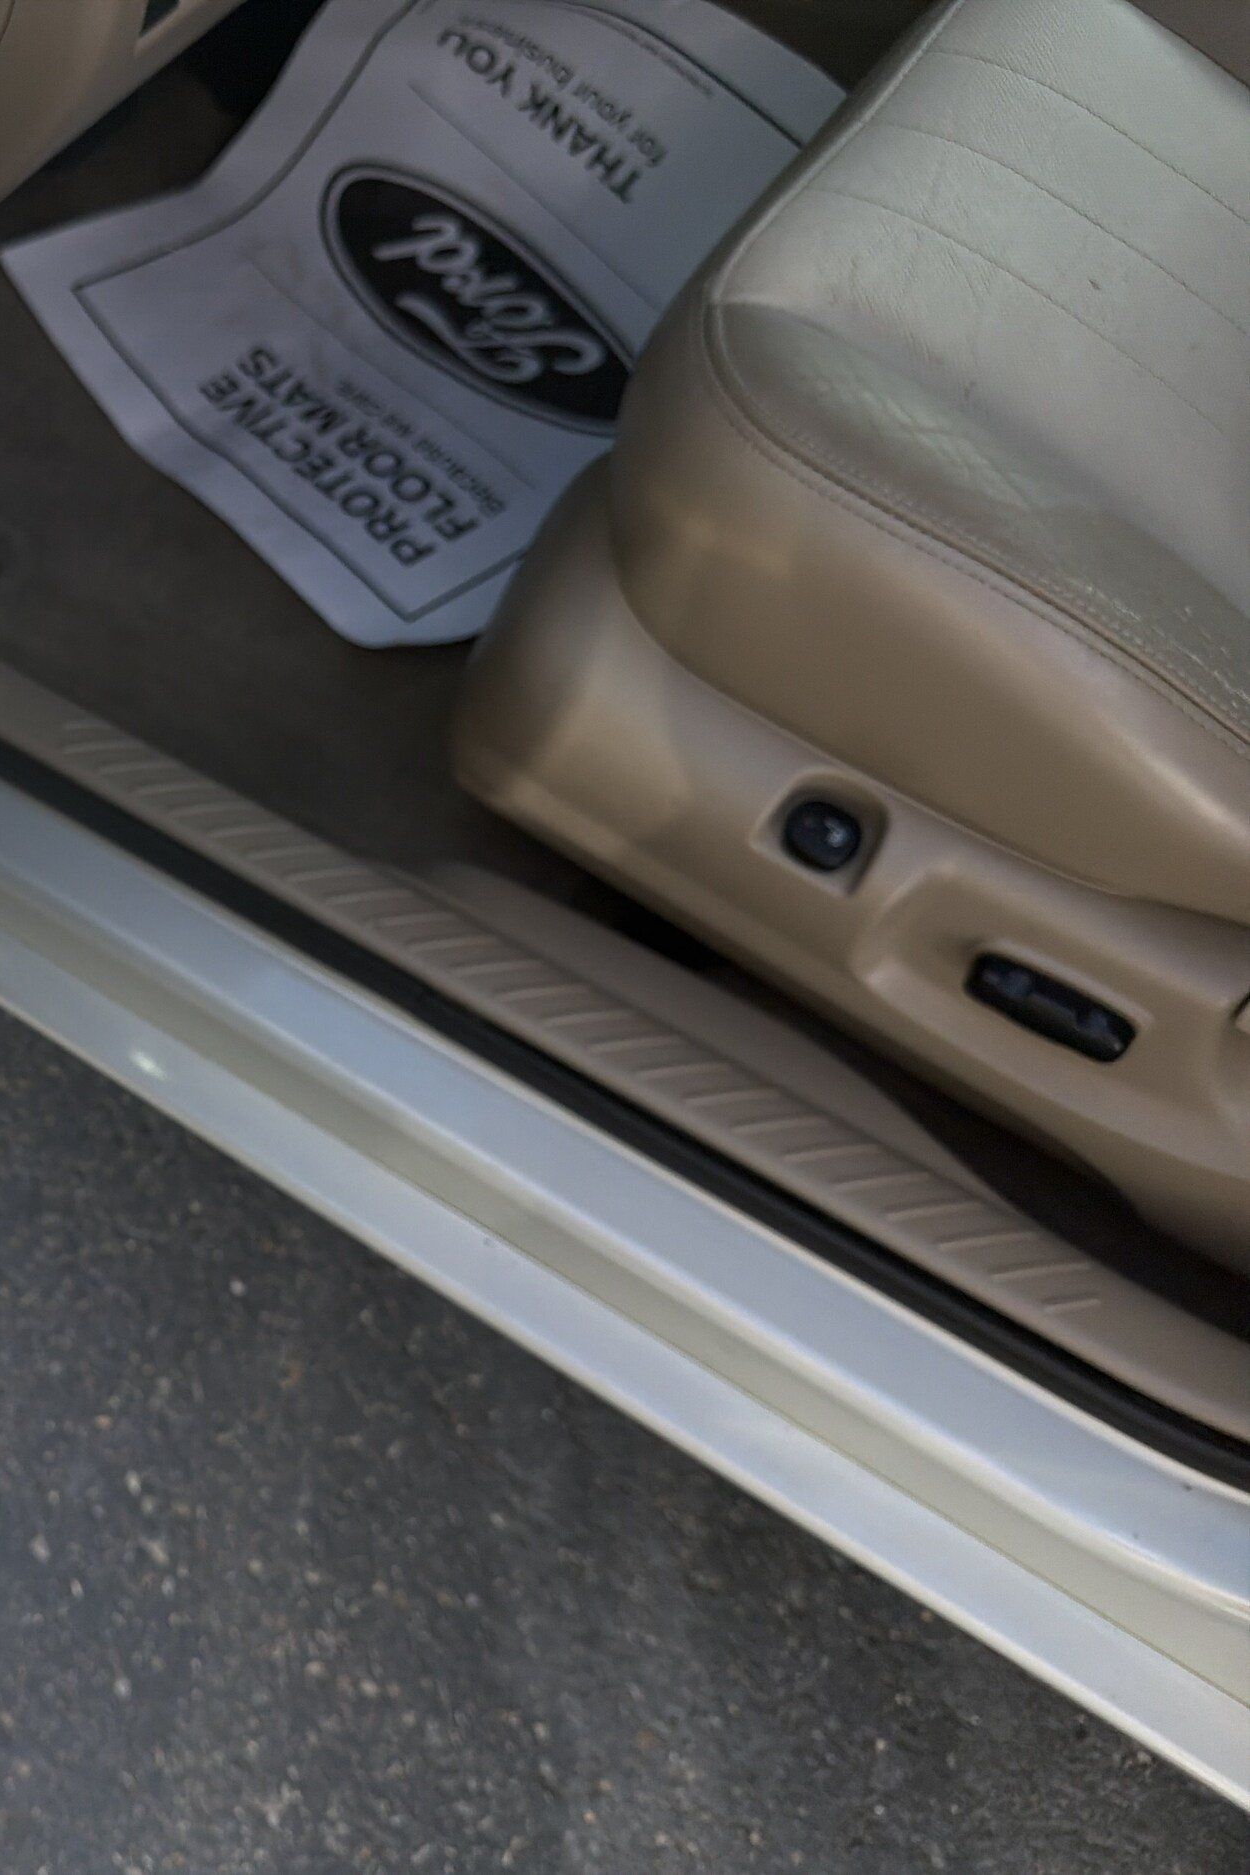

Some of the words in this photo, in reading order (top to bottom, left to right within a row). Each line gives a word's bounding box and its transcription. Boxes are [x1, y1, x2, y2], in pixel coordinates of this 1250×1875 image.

[437, 26, 515, 97] YOU
[572, 80, 632, 132] your
[518, 80, 641, 203] THANK
[627, 126, 668, 168] for
[371, 213, 605, 385] Ford
[237, 348, 347, 436] MATS
[198, 373, 437, 567] PROTECTIVE
[338, 426, 478, 541] FLOOR
